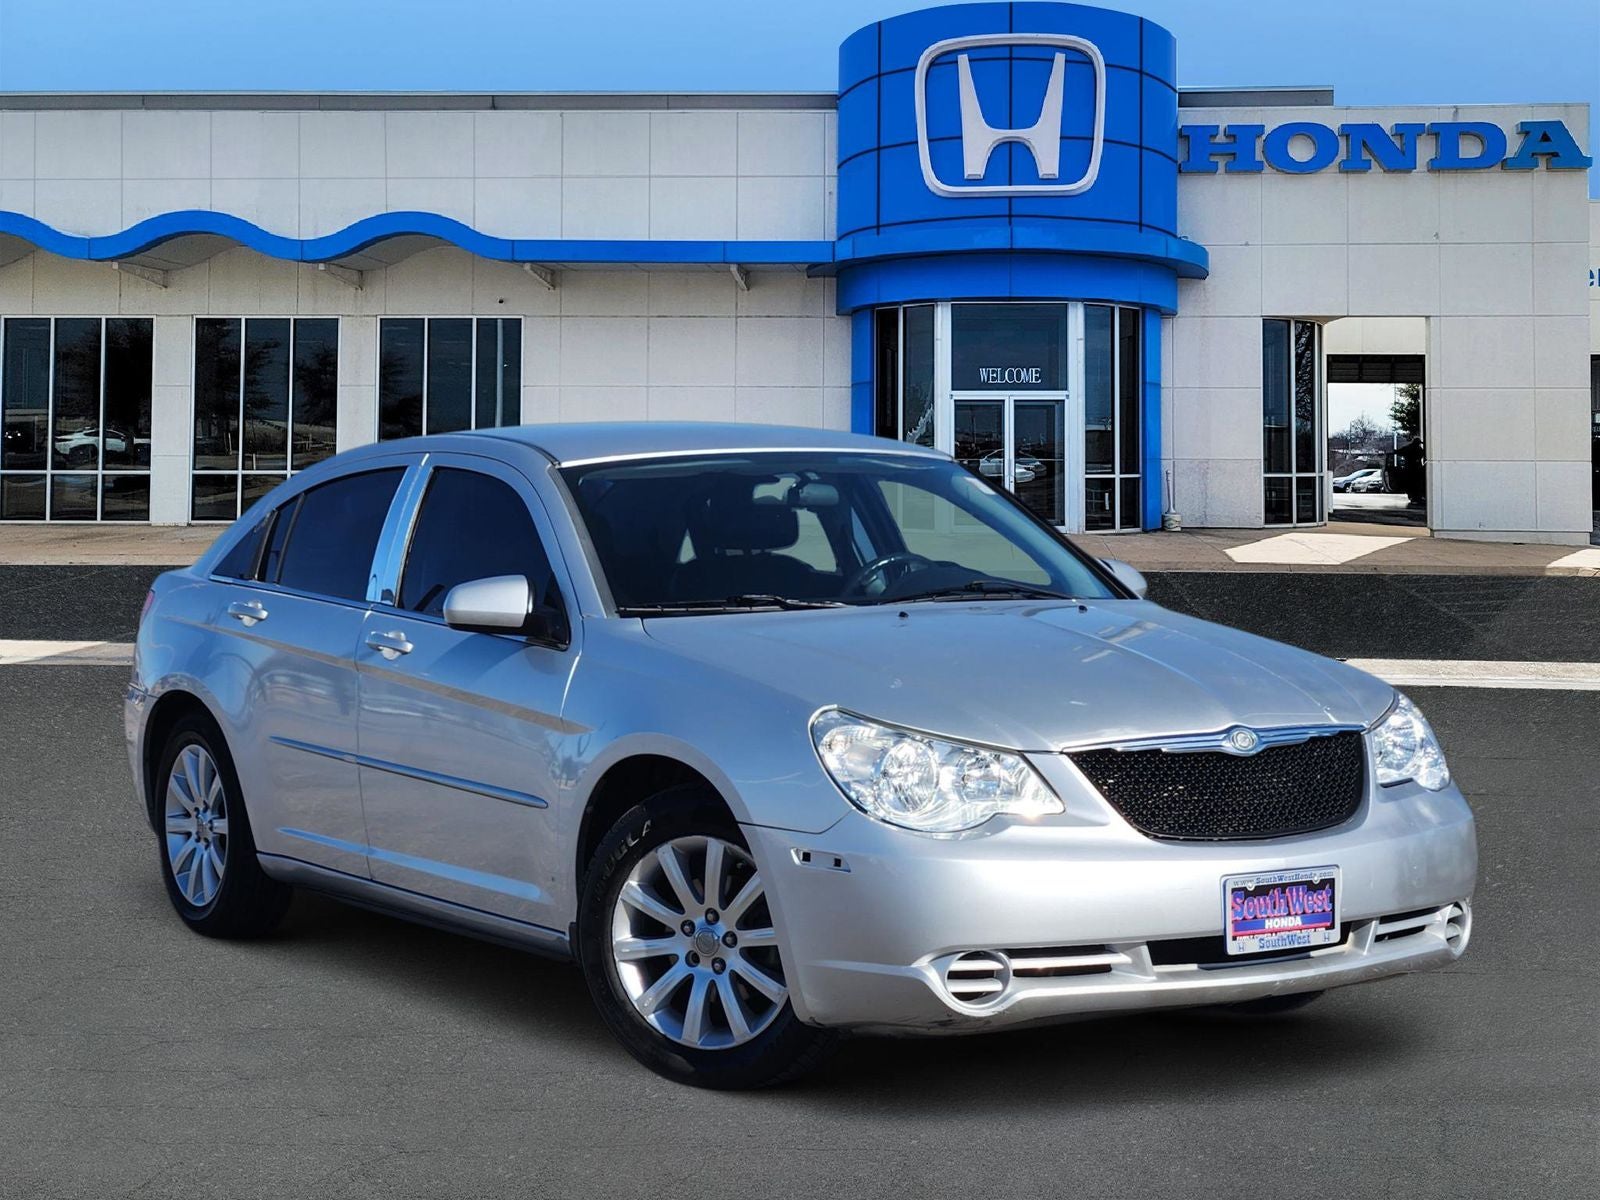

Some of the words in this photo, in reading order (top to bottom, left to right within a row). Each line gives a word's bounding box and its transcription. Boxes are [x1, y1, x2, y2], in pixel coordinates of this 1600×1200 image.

[1179, 121, 1593, 174] HONDA
[979, 367, 1042, 384] WELCOME
[1231, 883, 1333, 921] SouthWest
[1265, 916, 1302, 929] HONDA
[1259, 933, 1311, 950] SouthWest
